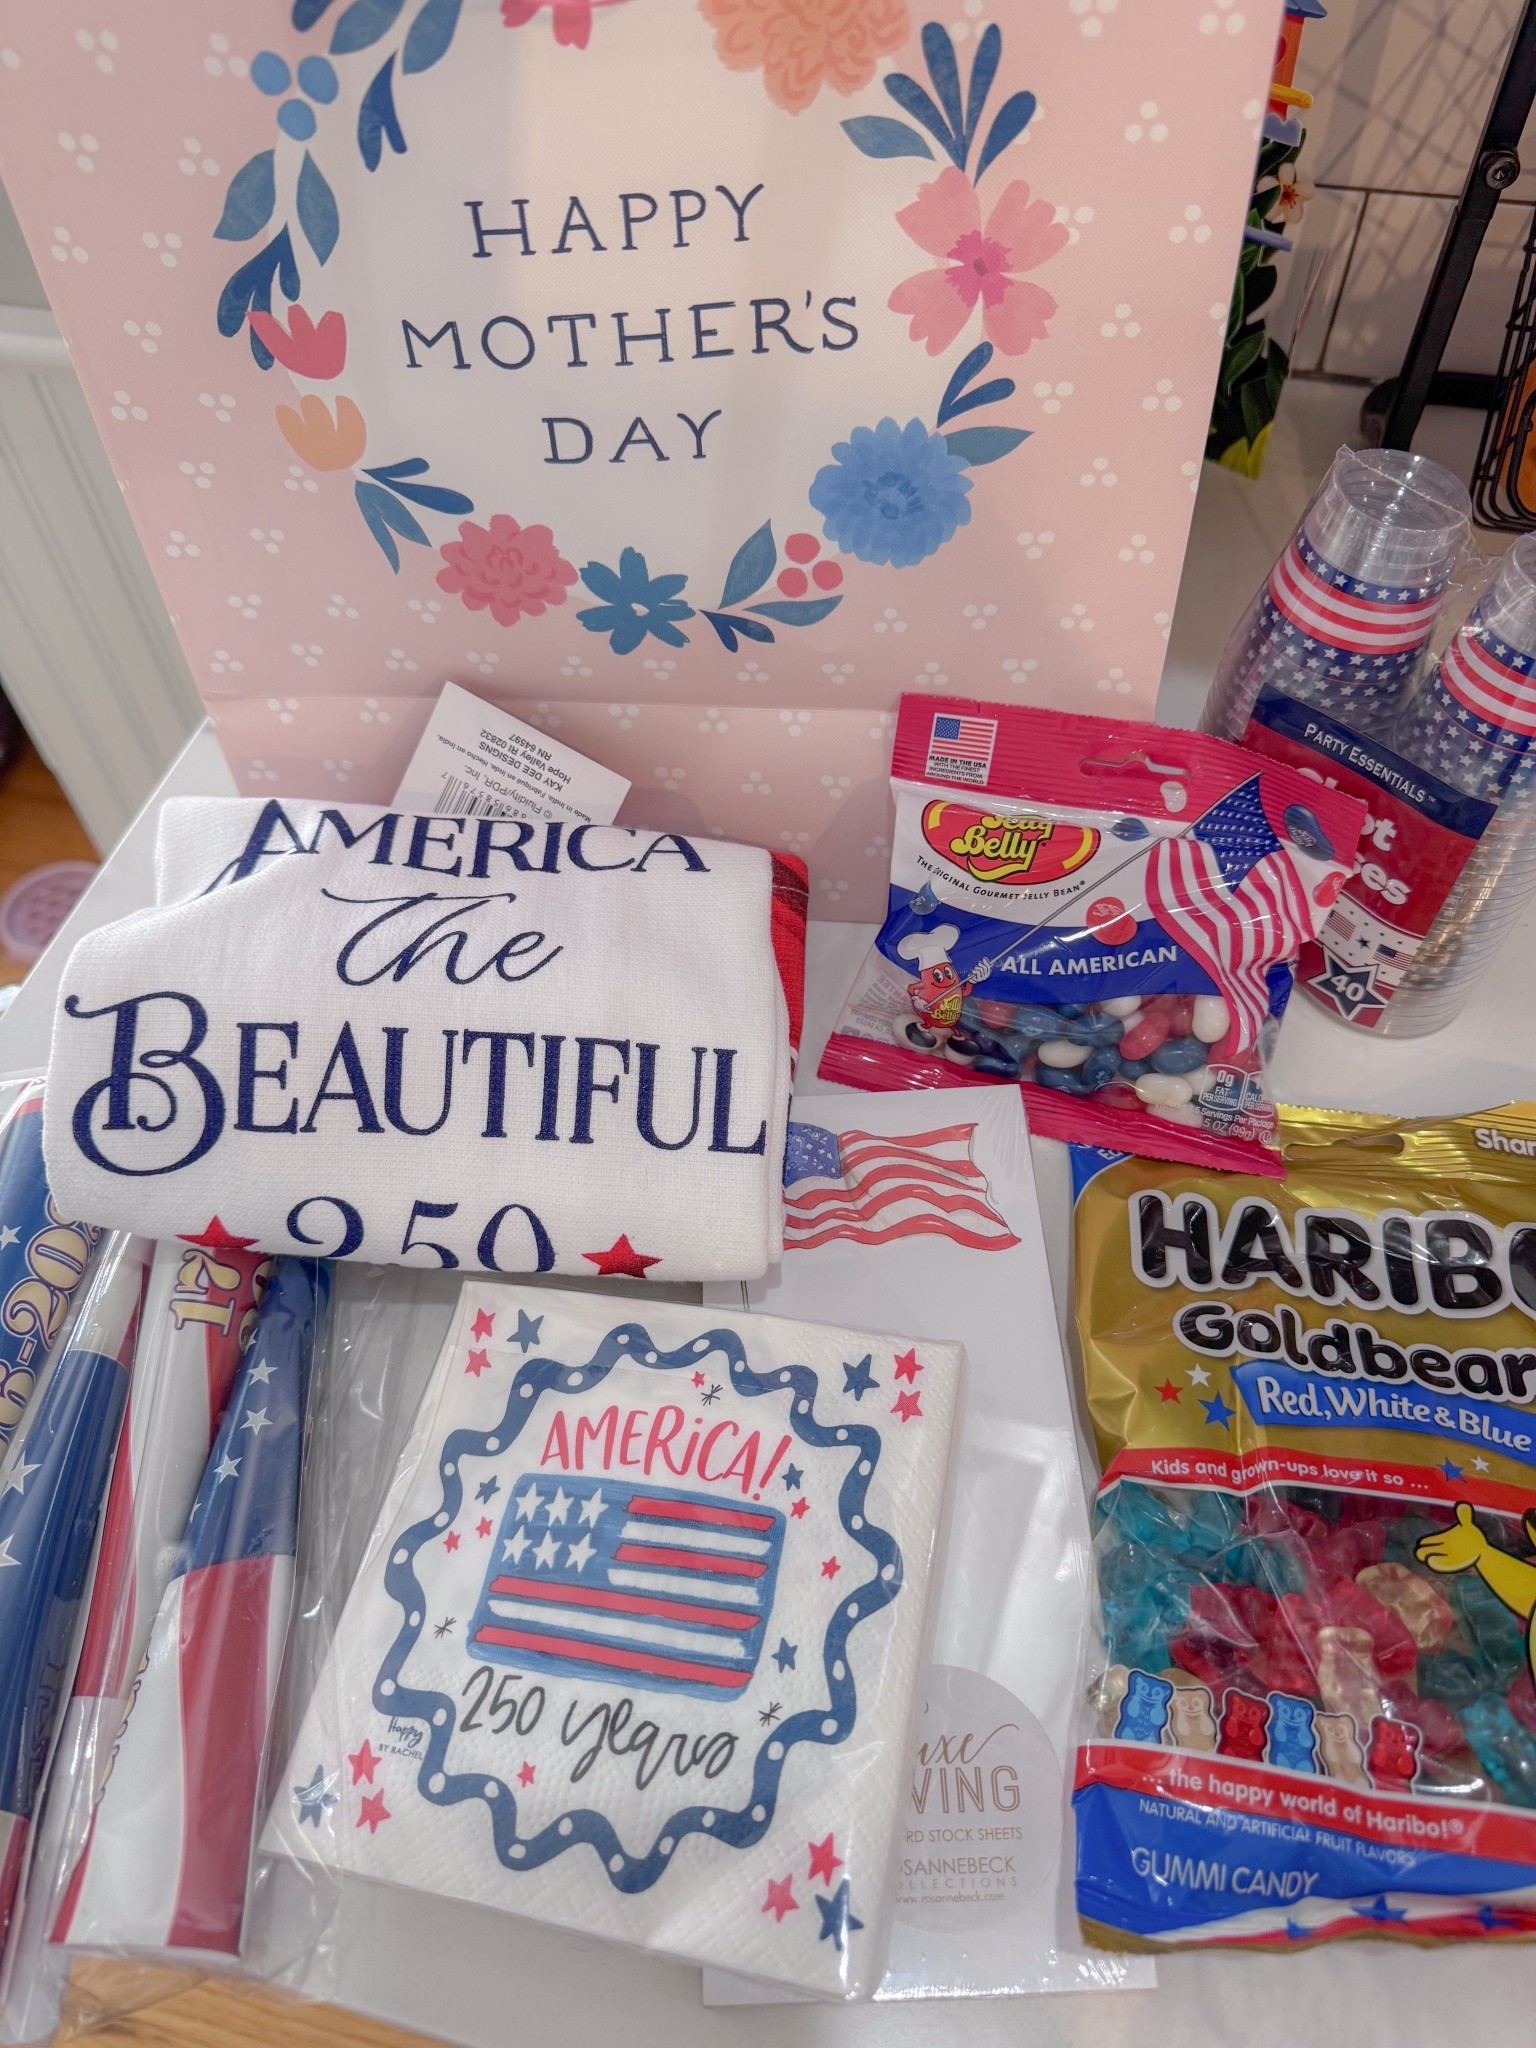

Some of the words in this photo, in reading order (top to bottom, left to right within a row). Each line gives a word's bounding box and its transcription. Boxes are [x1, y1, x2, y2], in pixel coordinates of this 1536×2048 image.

[464, 183, 764, 258] HAPPY
[401, 290, 859, 370] MOTHER'S
[542, 409, 721, 464] DAY
[436, 733, 456, 750] India.
[480, 729, 508, 750] 02832
[509, 733, 539, 755] 64597
[1304, 723, 1349, 755] PARTY
[466, 751, 488, 769] Hecho
[478, 741, 523, 770] DESIGNS
[520, 750, 547, 772] Valley
[538, 747, 553, 762] RN
[929, 755, 949, 763] MADE
[464, 764, 481, 782] Inc.
[522, 764, 543, 782] DEE
[548, 765, 572, 784] Hope
[929, 767, 965, 776] INGREDIENTS
[963, 777, 985, 785] WORLD
[483, 773, 543, 815] Fluidity/PDR,
[543, 776, 564, 793] KAY
[547, 794, 567, 811] India.
[573, 808, 592, 823] Made
[201, 799, 711, 897] AMERICA
[950, 825, 1038, 882] Belly
[916, 855, 932, 871] THE
[932, 867, 969, 892] ORIGINAL
[973, 886, 1020, 900] GOURMET
[1022, 891, 1049, 900] JELLY
[321, 888, 564, 987] The
[1000, 956, 1041, 976] ALL
[1048, 945, 1178, 977] AMERICAN
[1331, 972, 1365, 1002] 40
[65, 989, 766, 1177] BEAUTIFUL
[1217, 1069, 1235, 1087] 0g
[1202, 1092, 1215, 1102] PER
[1214, 1095, 1238, 1107] SERVING
[1215, 1086, 1228, 1097] FAT
[1200, 1108, 1234, 1121] Servings
[1234, 1114, 1248, 1124] Per
[1247, 1117, 1274, 1130] Package
[1212, 1121, 1229, 1133] OZ
[1228, 1124, 1256, 1141] (99g)
[1459, 1408, 1532, 1452] Blue
[1151, 1459, 1190, 1475] Kids
[1195, 1460, 1227, 1478] and
[1231, 1459, 1318, 1485] grown-ups
[1323, 1464, 1362, 1480] love
[1365, 1469, 1378, 1482] it
[1383, 1473, 1404, 1486] so
[459, 1666, 545, 1736] 250
[561, 1697, 740, 1790] years
[379, 1743, 389, 1752] BY
[391, 1746, 423, 1760] RACHEL
[1169, 1768, 1202, 1790] the
[1208, 1774, 1274, 1807] happy
[1280, 1788, 1337, 1818] world
[1343, 1803, 1363, 1823] of
[928, 1828, 974, 1843] STOCK
[978, 1826, 1023, 1841] SHEETS
[1139, 1798, 1201, 1825] NATURAL
[1206, 1812, 1237, 1831] AND
[1240, 1818, 1312, 1842] ARTIFICIAL
[1316, 1833, 1352, 1852] FRUIT
[1356, 1841, 1415, 1867] FLAVORS
[901, 1856, 1016, 1876] SANNEBECK
[1131, 1847, 1227, 1892] GUMMI
[1231, 1865, 1319, 1898] CANDY
